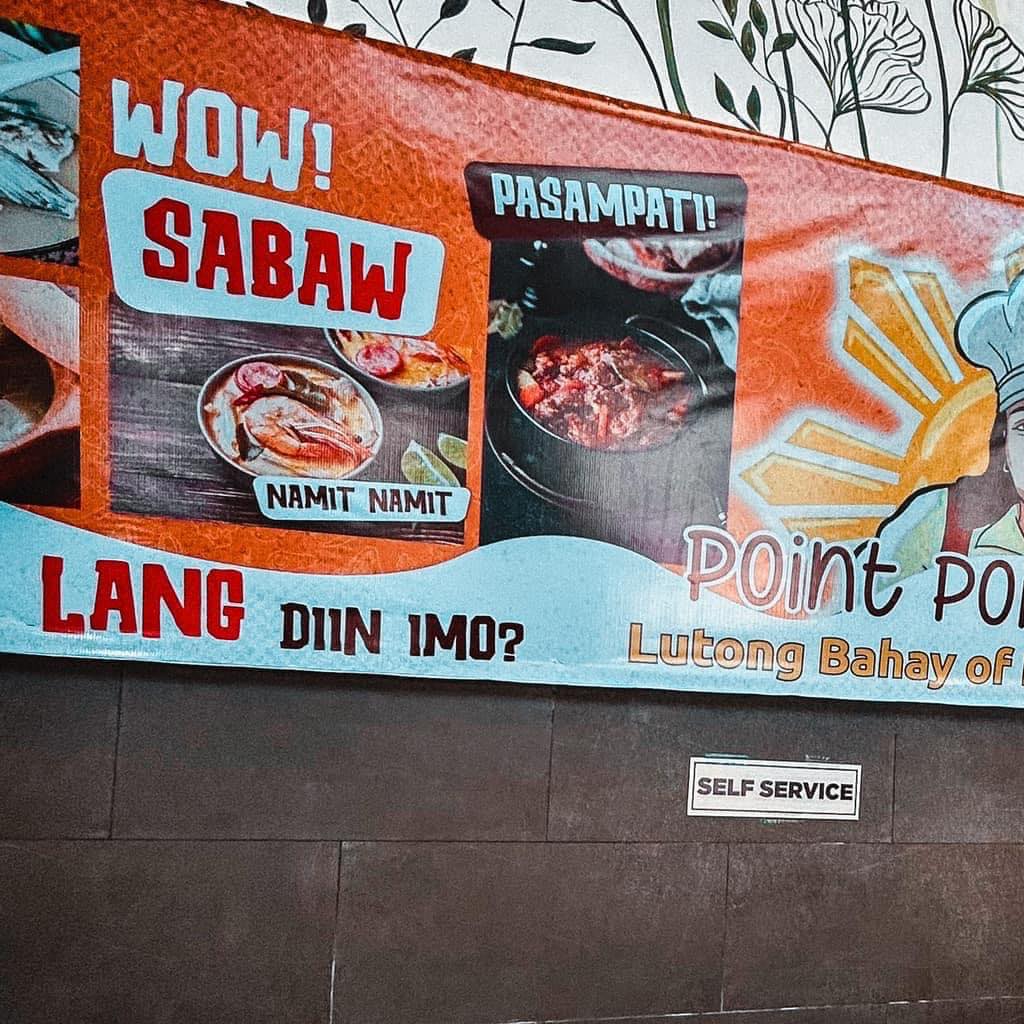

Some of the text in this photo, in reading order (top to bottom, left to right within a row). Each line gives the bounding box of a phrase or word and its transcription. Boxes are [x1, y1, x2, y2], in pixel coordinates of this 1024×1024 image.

[111, 78, 333, 192] WOW!
[490, 172, 717, 233] PASAMPATI!
[142, 197, 413, 321] SABAW
[266, 482, 454, 517] NAMIT NAMIT
[42, 554, 525, 662] LANG DIIN IMO?
[628, 622, 805, 682] Lutong
[818, 636, 957, 690] Bahay
[965, 646, 1016, 685] of
[697, 776, 854, 801] SELF SERVICE
